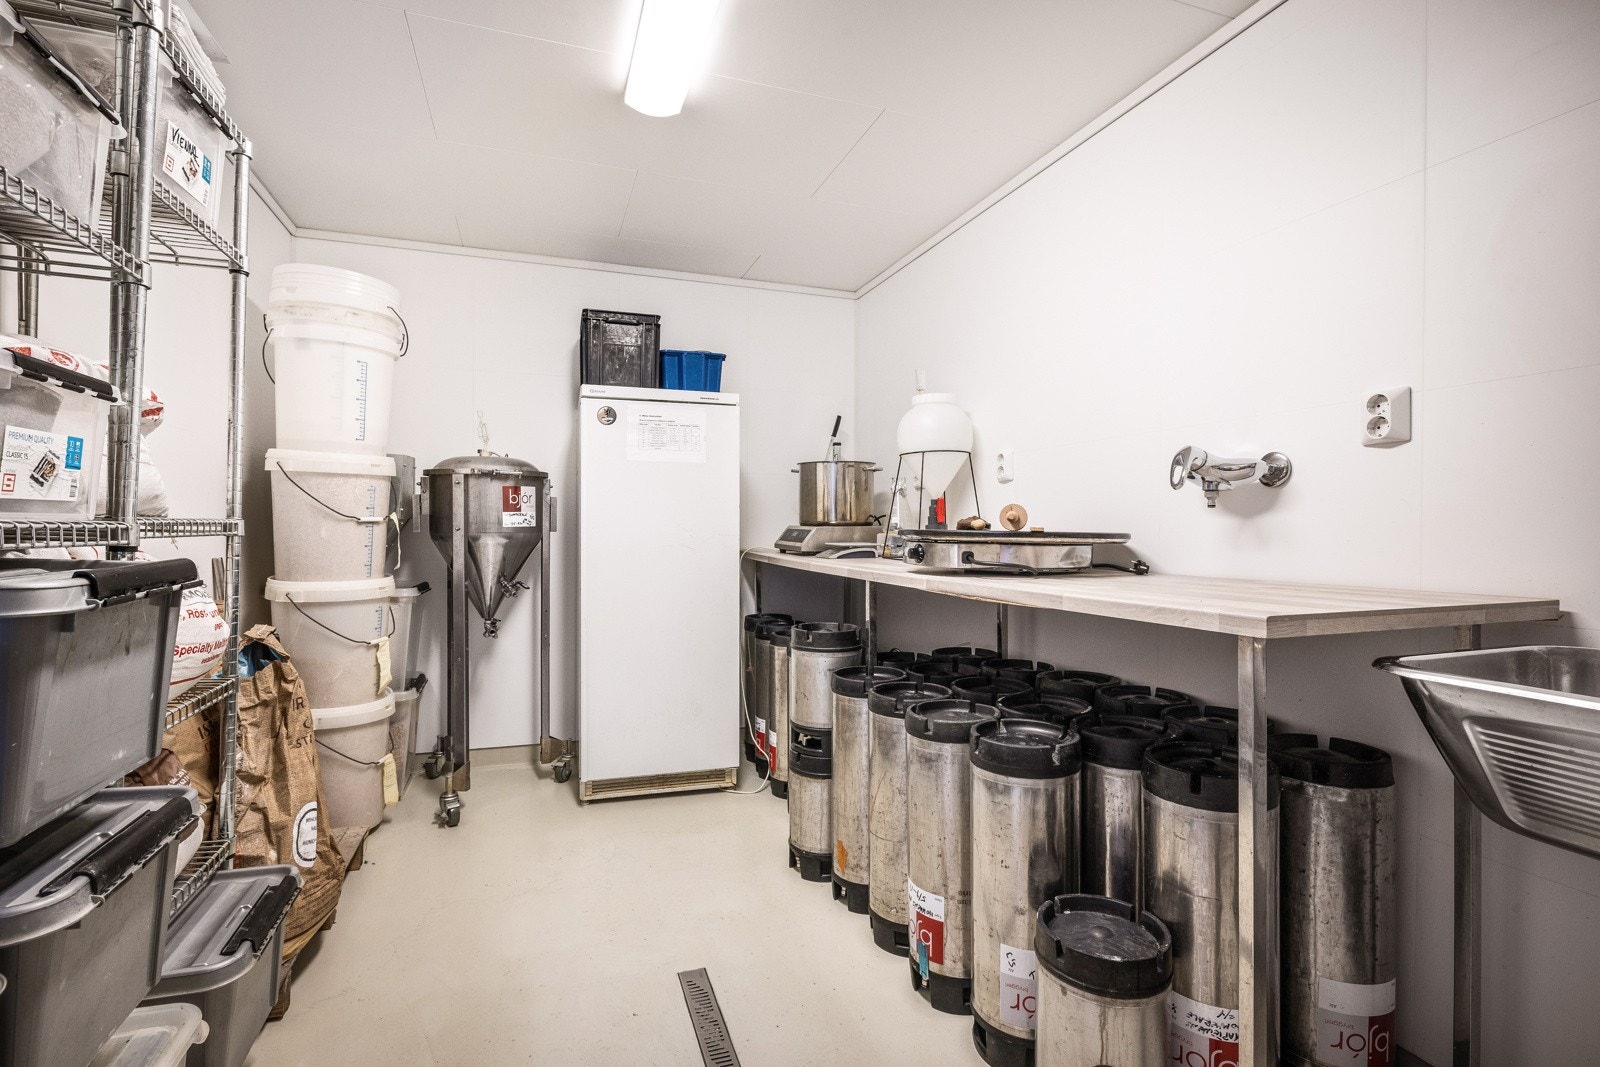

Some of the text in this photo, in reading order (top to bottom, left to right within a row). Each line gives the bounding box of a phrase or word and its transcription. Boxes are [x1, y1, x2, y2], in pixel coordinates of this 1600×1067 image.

[5, 450, 23, 459] CLASSIC
[509, 488, 533, 509] bjór
[173, 642, 212, 658] Specialty
[1330, 1025, 1390, 1063] bjór
